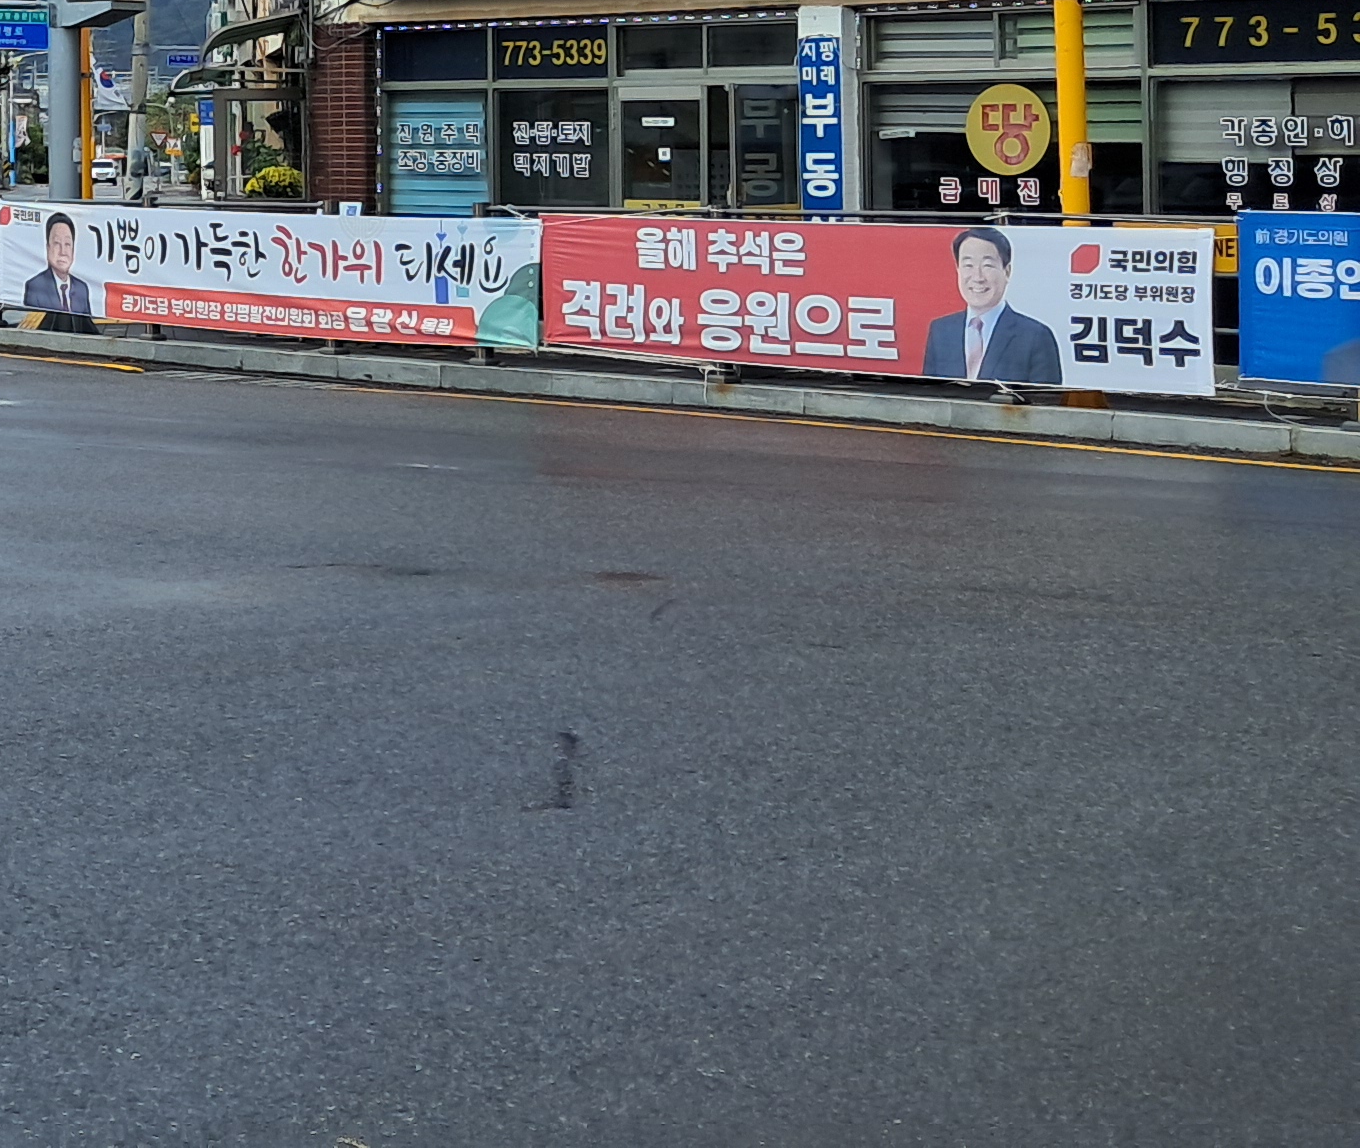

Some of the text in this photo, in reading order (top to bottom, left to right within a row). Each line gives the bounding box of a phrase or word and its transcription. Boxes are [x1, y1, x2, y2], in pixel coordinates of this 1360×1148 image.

[501, 38, 607, 67] 773-5339
[802, 40, 836, 62] 지평
[981, 103, 1040, 166] 땅
[87, 216, 168, 274] 기쁨이
[174, 222, 267, 282] 가득한
[270, 223, 383, 285] 한가위
[635, 226, 807, 276] 올해 추석은
[1273, 228, 1349, 247] 경기도의원
[1108, 249, 1198, 275] 국민의힘
[1069, 283, 1130, 302] 경기도당
[561, 279, 900, 361] 격려와 응원으로
[1069, 315, 1202, 368] 김덕수
